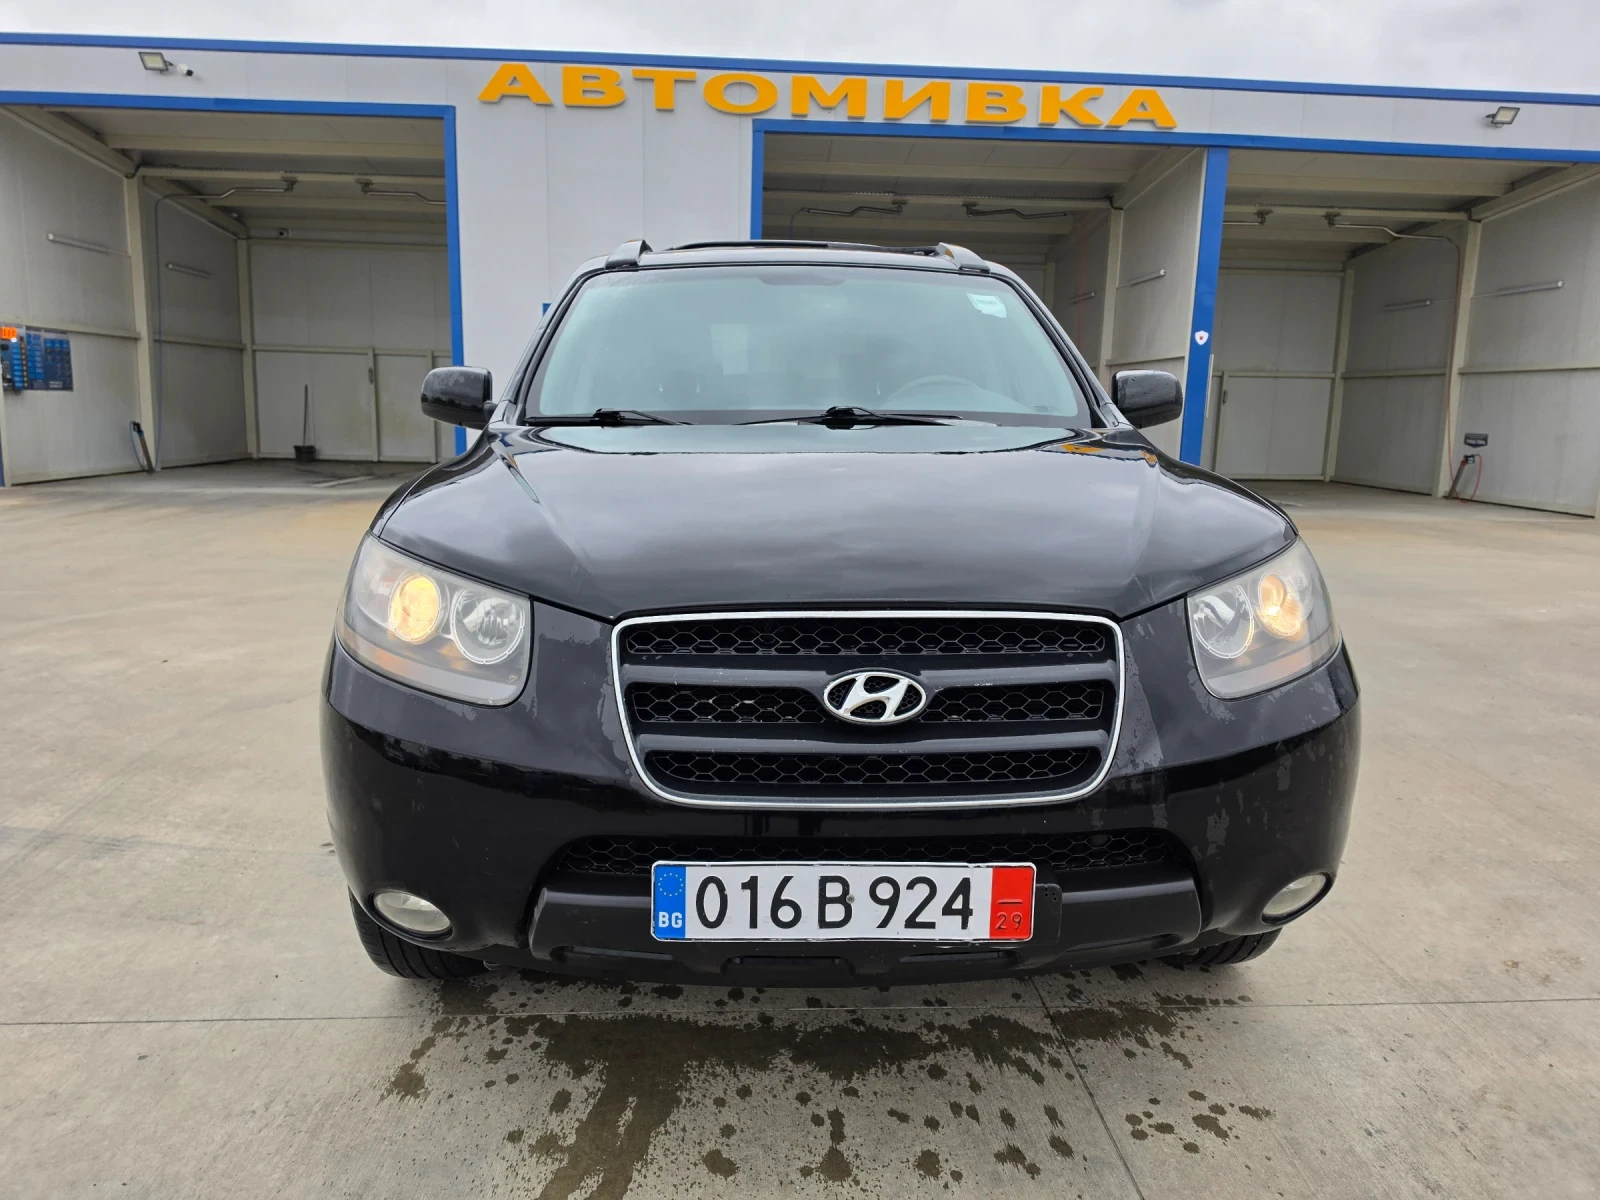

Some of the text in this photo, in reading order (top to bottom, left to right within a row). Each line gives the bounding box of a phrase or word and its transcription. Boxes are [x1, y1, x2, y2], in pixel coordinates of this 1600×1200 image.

[478, 63, 1178, 129] АВТОМИВКА
[658, 911, 683, 929] BG
[995, 911, 1023, 932] 29
